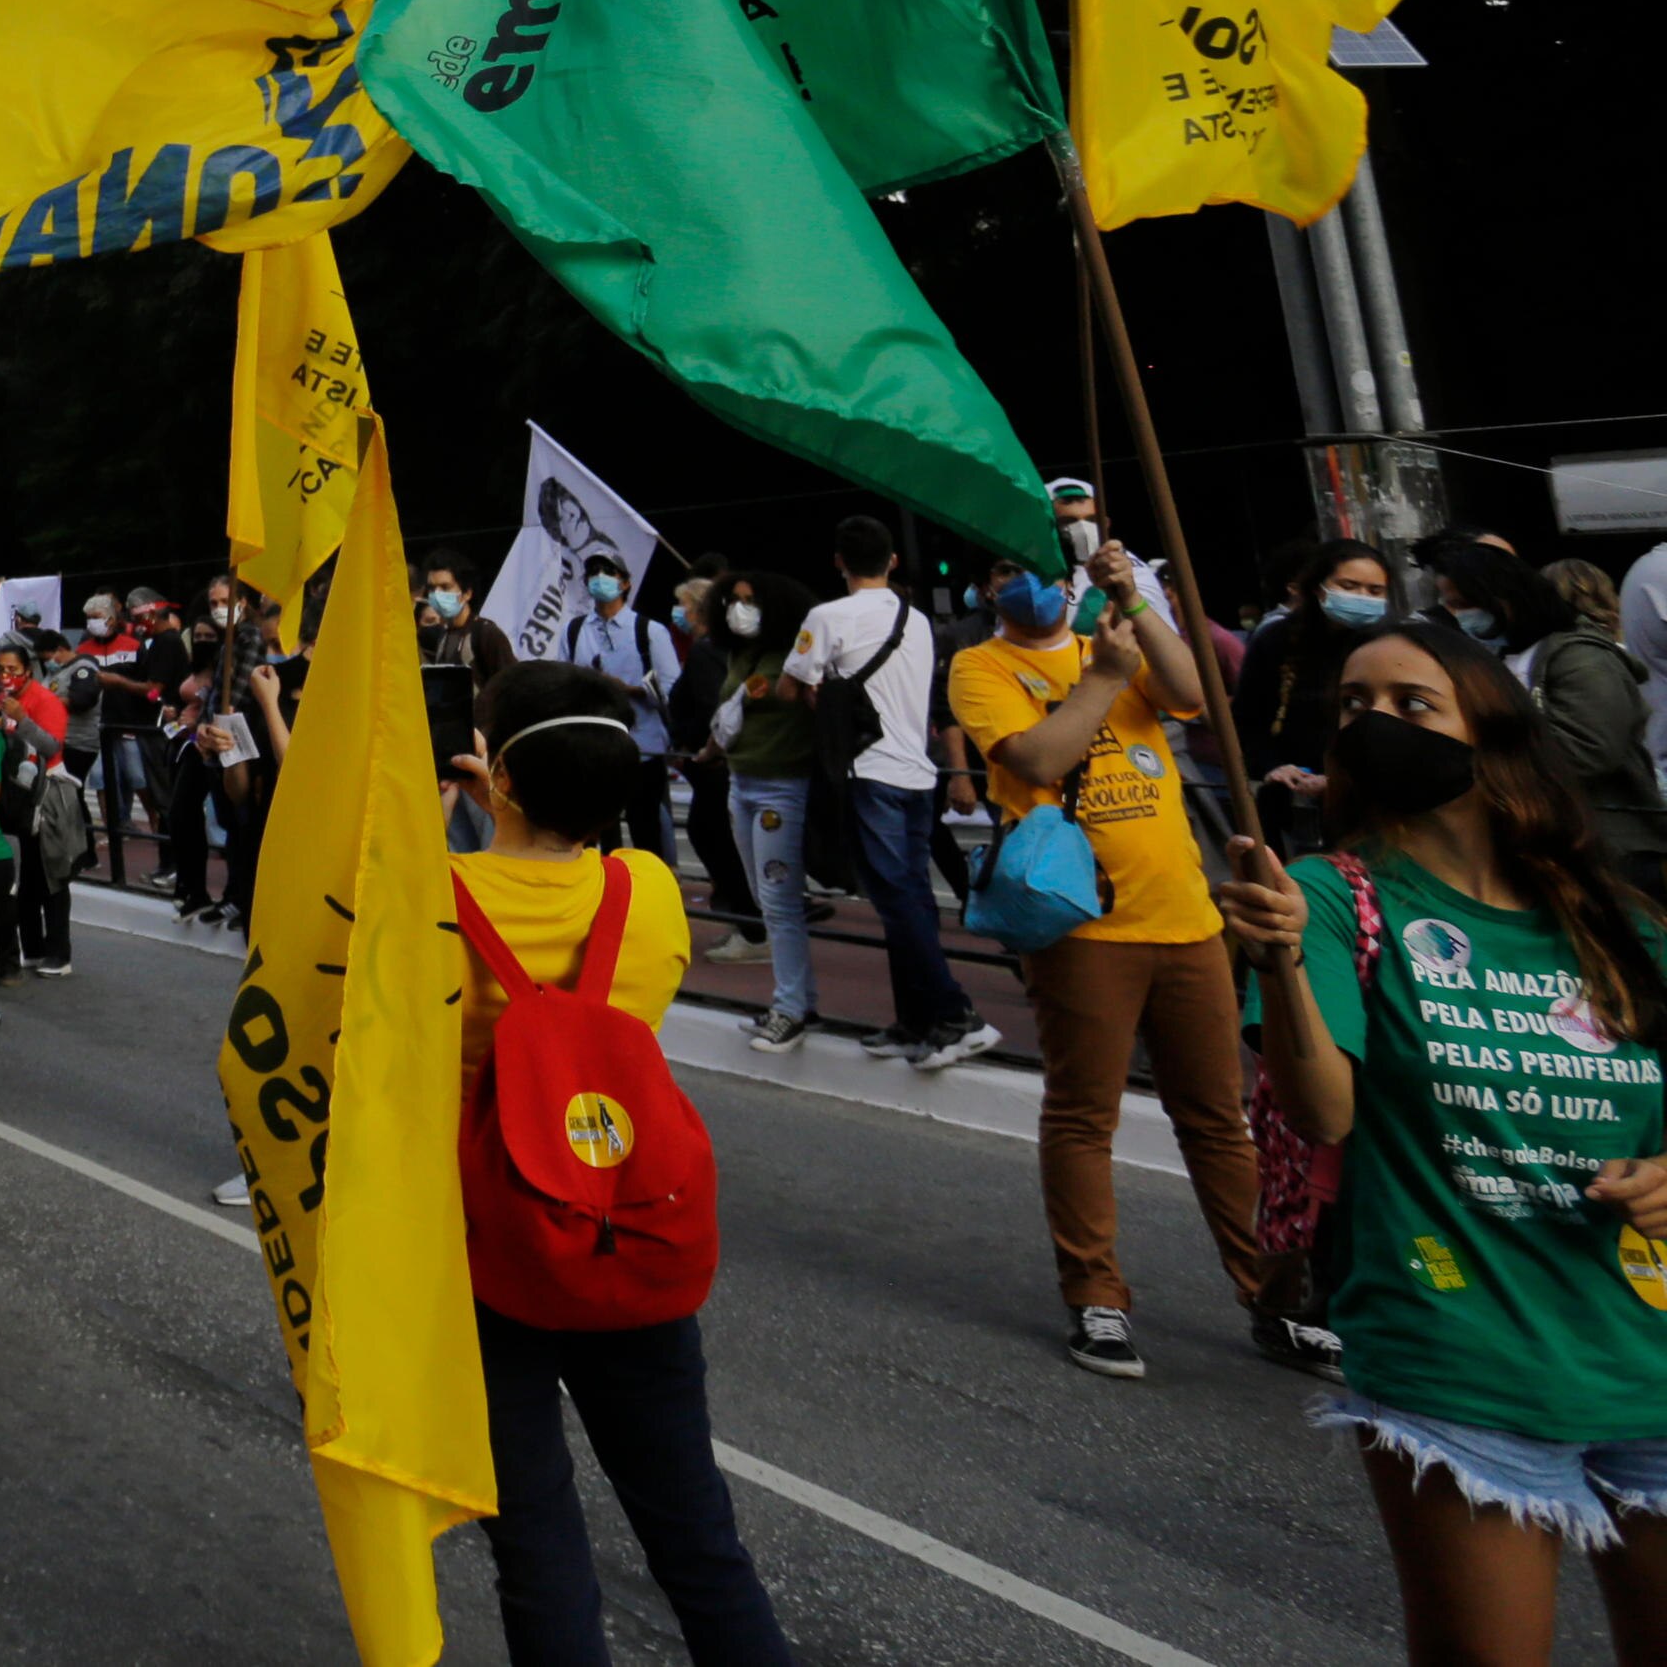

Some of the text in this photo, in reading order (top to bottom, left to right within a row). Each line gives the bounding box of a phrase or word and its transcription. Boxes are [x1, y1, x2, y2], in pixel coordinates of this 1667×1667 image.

[1411, 959, 1584, 999] PELA AMAZÔ
[1419, 998, 1488, 1031] PELA
[1426, 1040, 1663, 1084] PELAS PERIFERIAS
[1432, 1081, 1621, 1122] UMA SÓ LUTA.
